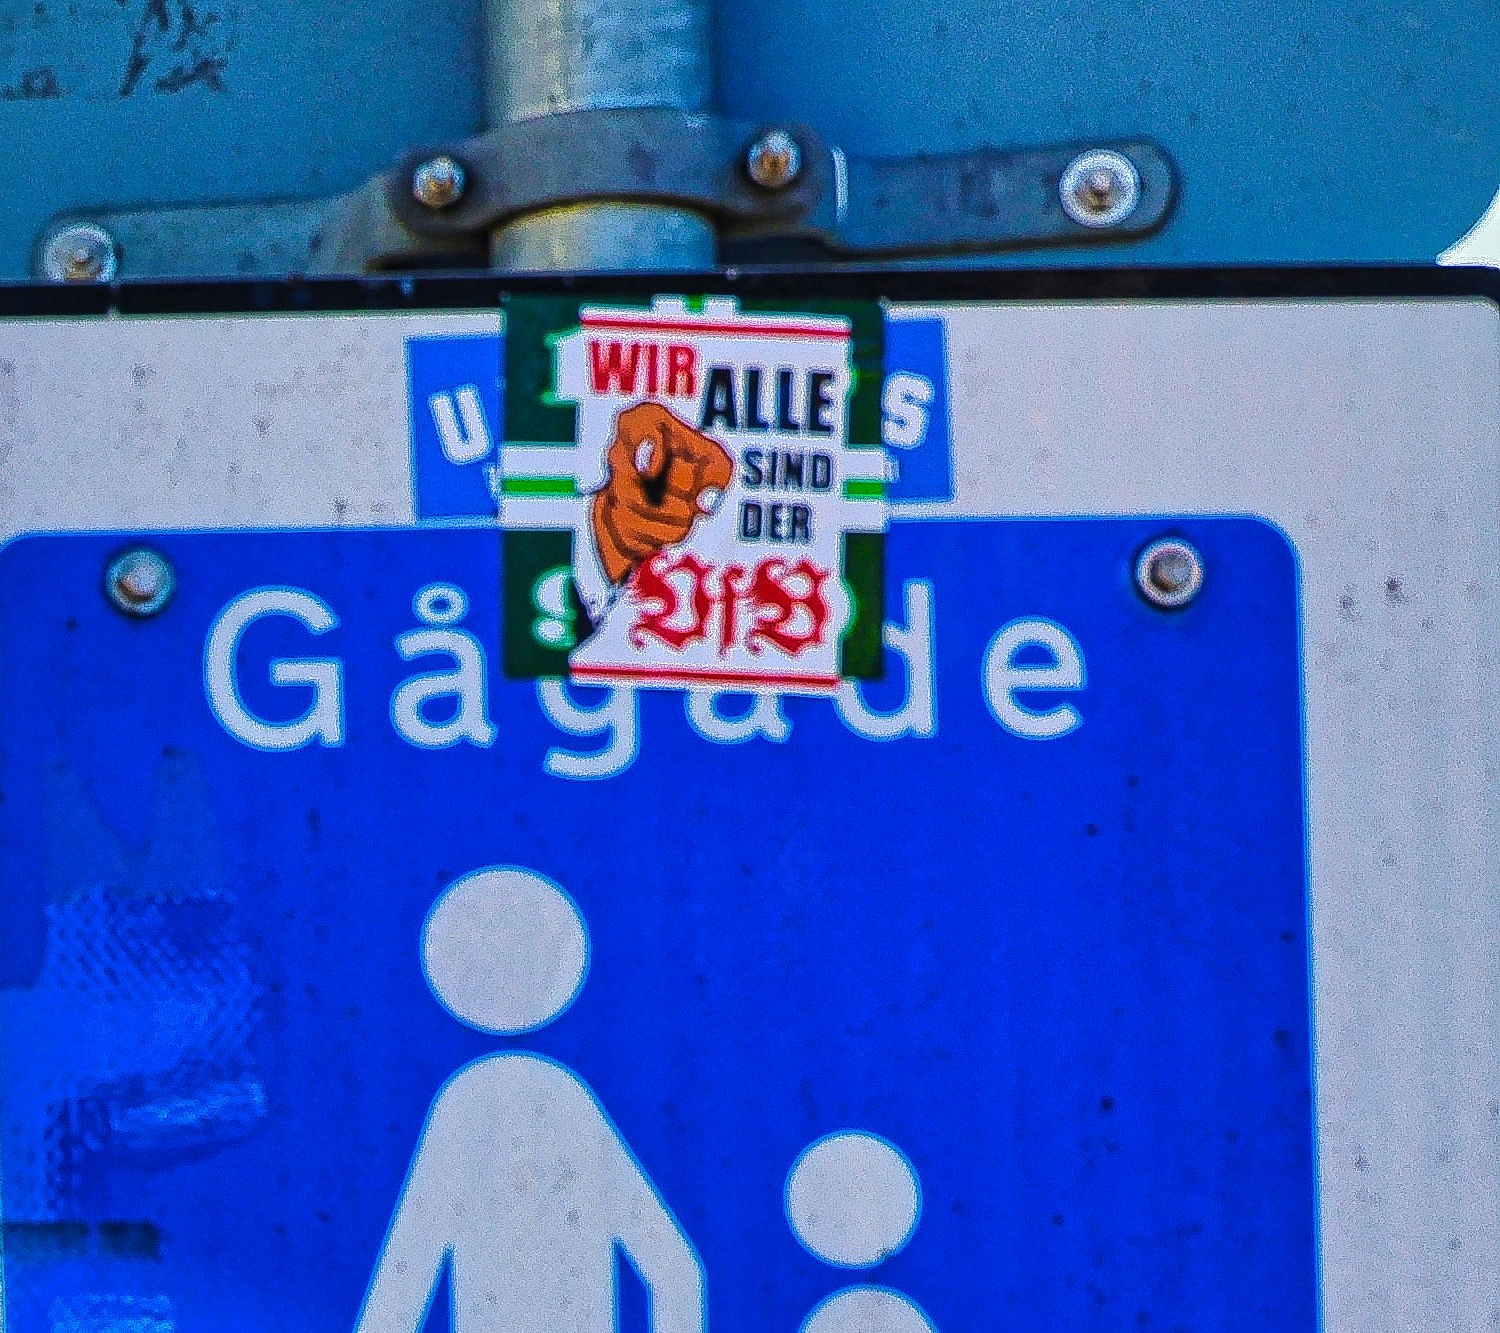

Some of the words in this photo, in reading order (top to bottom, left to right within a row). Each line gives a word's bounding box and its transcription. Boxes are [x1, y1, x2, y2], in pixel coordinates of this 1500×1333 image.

[589, 340, 699, 397] WIR
[700, 367, 835, 435] ALLE
[741, 449, 833, 493] SIND
[741, 502, 811, 541] DER
